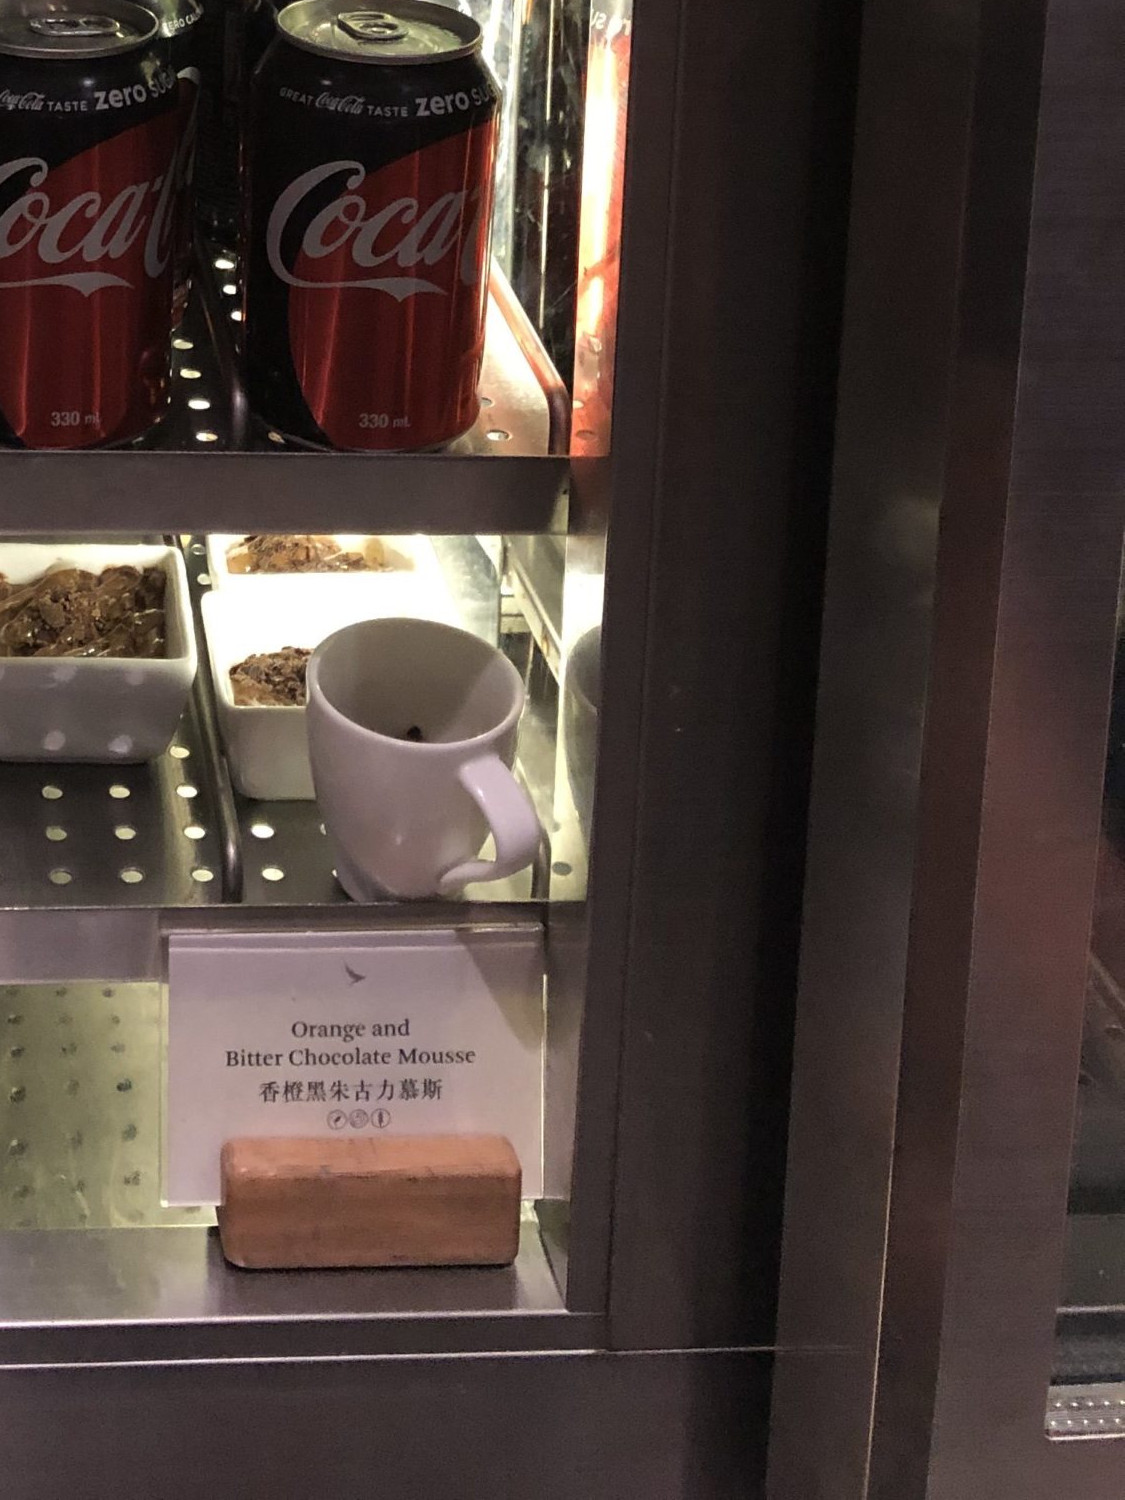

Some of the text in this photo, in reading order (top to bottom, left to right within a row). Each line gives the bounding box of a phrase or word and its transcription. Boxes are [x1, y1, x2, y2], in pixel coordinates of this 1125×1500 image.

[46, 100, 88, 113] TASTE
[93, 83, 147, 111] zero
[278, 86, 316, 107] GREAT
[366, 104, 409, 118] TASTE
[414, 90, 470, 117] zero
[50, 411, 81, 428] 330
[358, 413, 389, 429] 330
[291, 1018, 410, 1043] Orange and
[225, 1047, 476, 1067] Bitter Chocolate Mousse
[259, 1078, 443, 1103] 香橙黑朱古力慕斯
